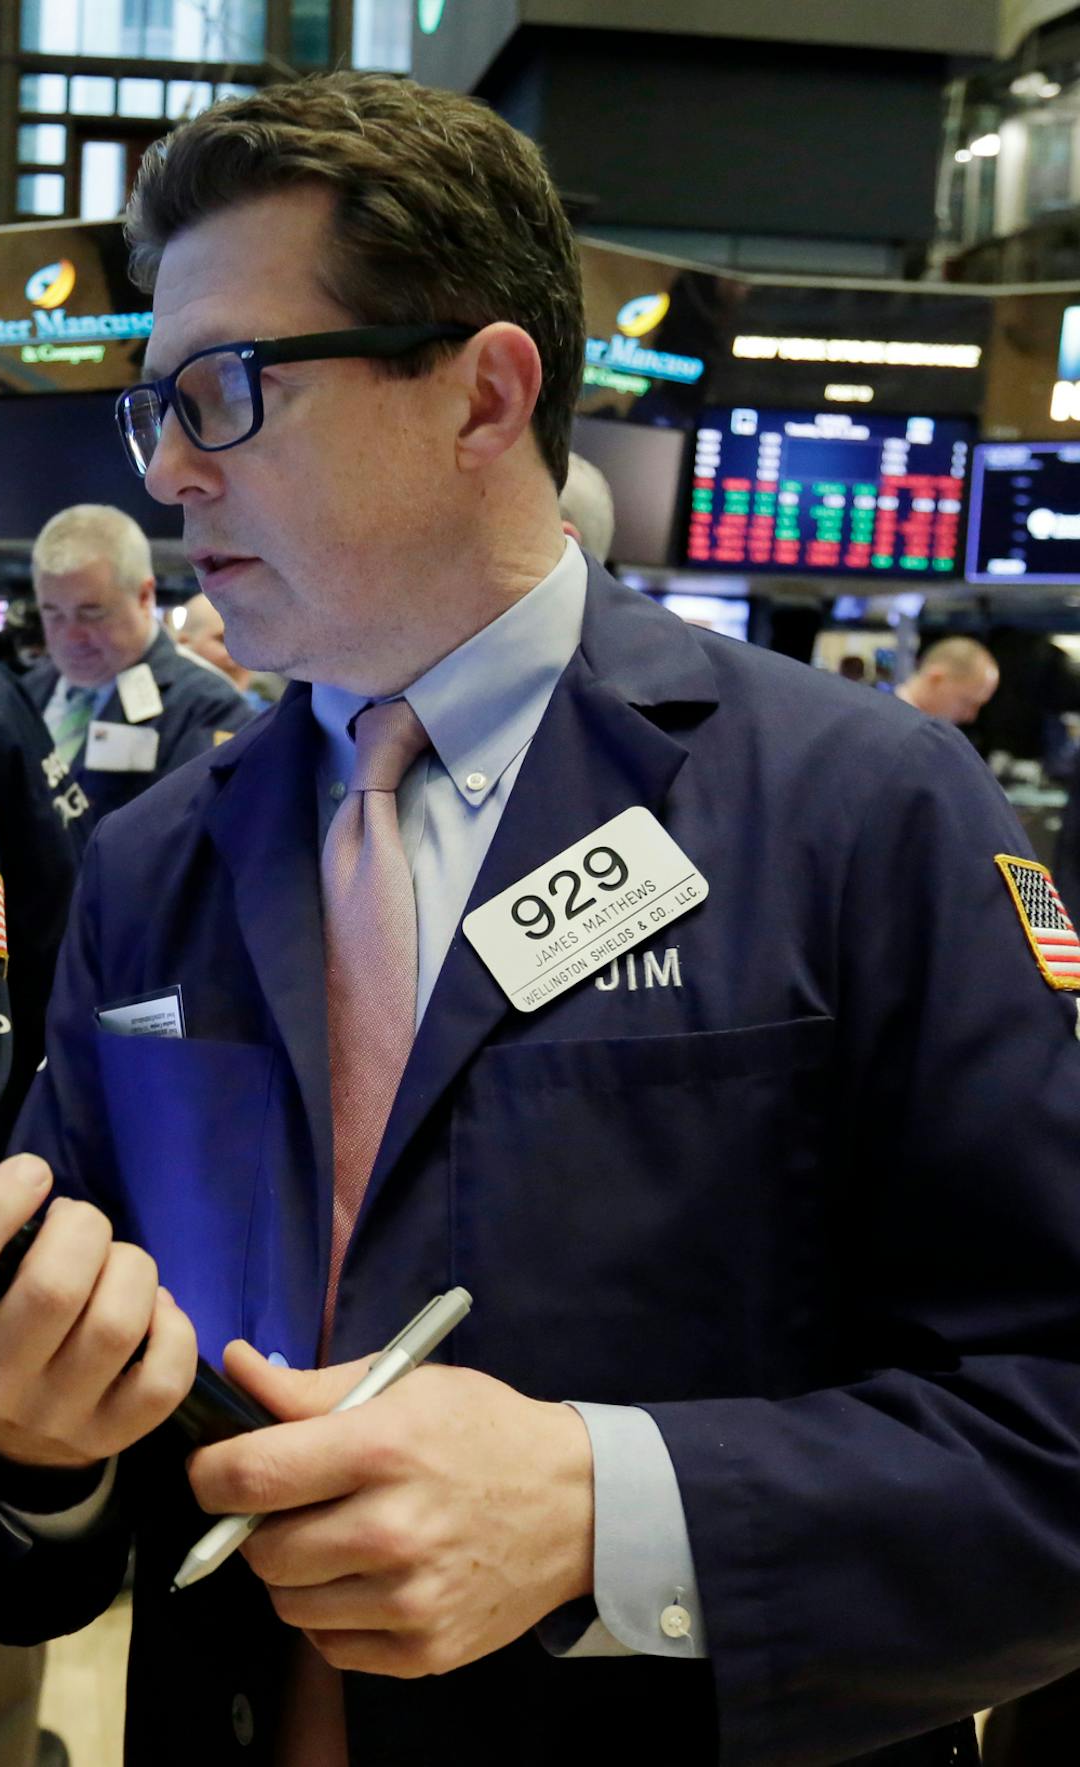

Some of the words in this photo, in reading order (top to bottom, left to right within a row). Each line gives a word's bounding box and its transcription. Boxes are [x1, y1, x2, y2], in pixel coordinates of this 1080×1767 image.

[511, 846, 629, 940] 929
[535, 931, 580, 968] JAMES
[582, 879, 658, 934] MATTHEWS
[523, 958, 589, 1007] WELLINGTON
[590, 927, 636, 963] SHIELDS
[637, 920, 649, 932] &
[594, 948, 683, 992] JIM
